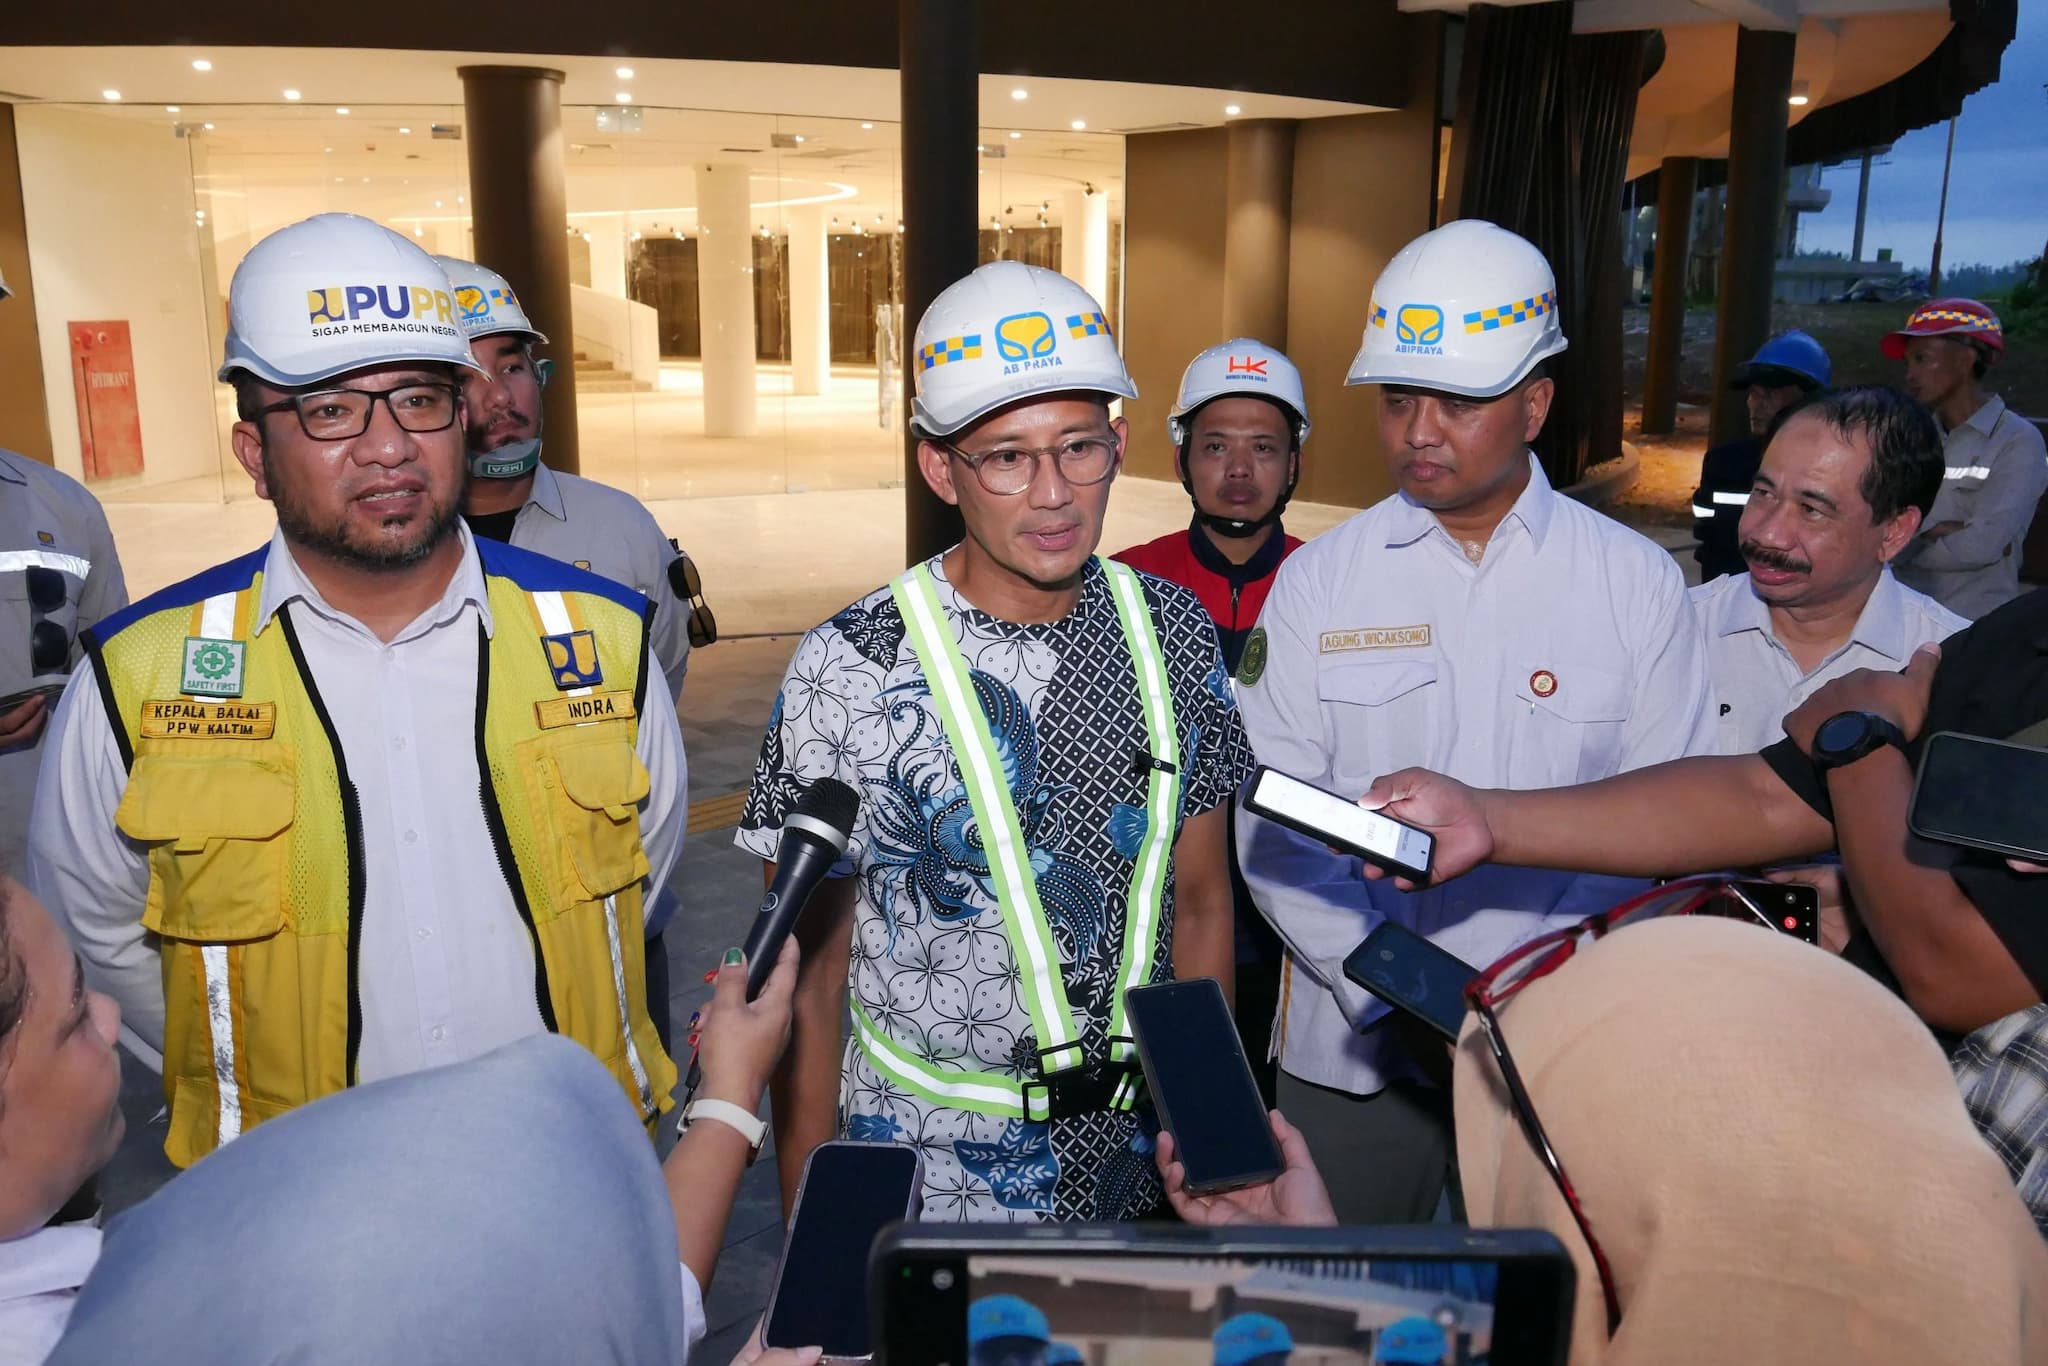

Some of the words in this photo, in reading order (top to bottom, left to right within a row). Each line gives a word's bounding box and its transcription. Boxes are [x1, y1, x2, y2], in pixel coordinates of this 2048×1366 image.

[345, 285, 455, 325] PUPR
[312, 325, 349, 337] SIGAP
[353, 323, 429, 334] MEMBANGUN
[1395, 344, 1443, 355] ABIPRAYA
[1229, 356, 1268, 375] HK
[1325, 633, 1360, 648] AGUNG
[1363, 629, 1427, 645] WICAKSONO
[186, 680, 214, 690] SAFETY
[216, 681, 237, 691] FIRST
[155, 705, 206, 718] KEPALA
[216, 707, 260, 719] BALAI
[568, 697, 614, 718] INDRA
[167, 721, 200, 733] PPW
[207, 723, 253, 735] KALTIM
